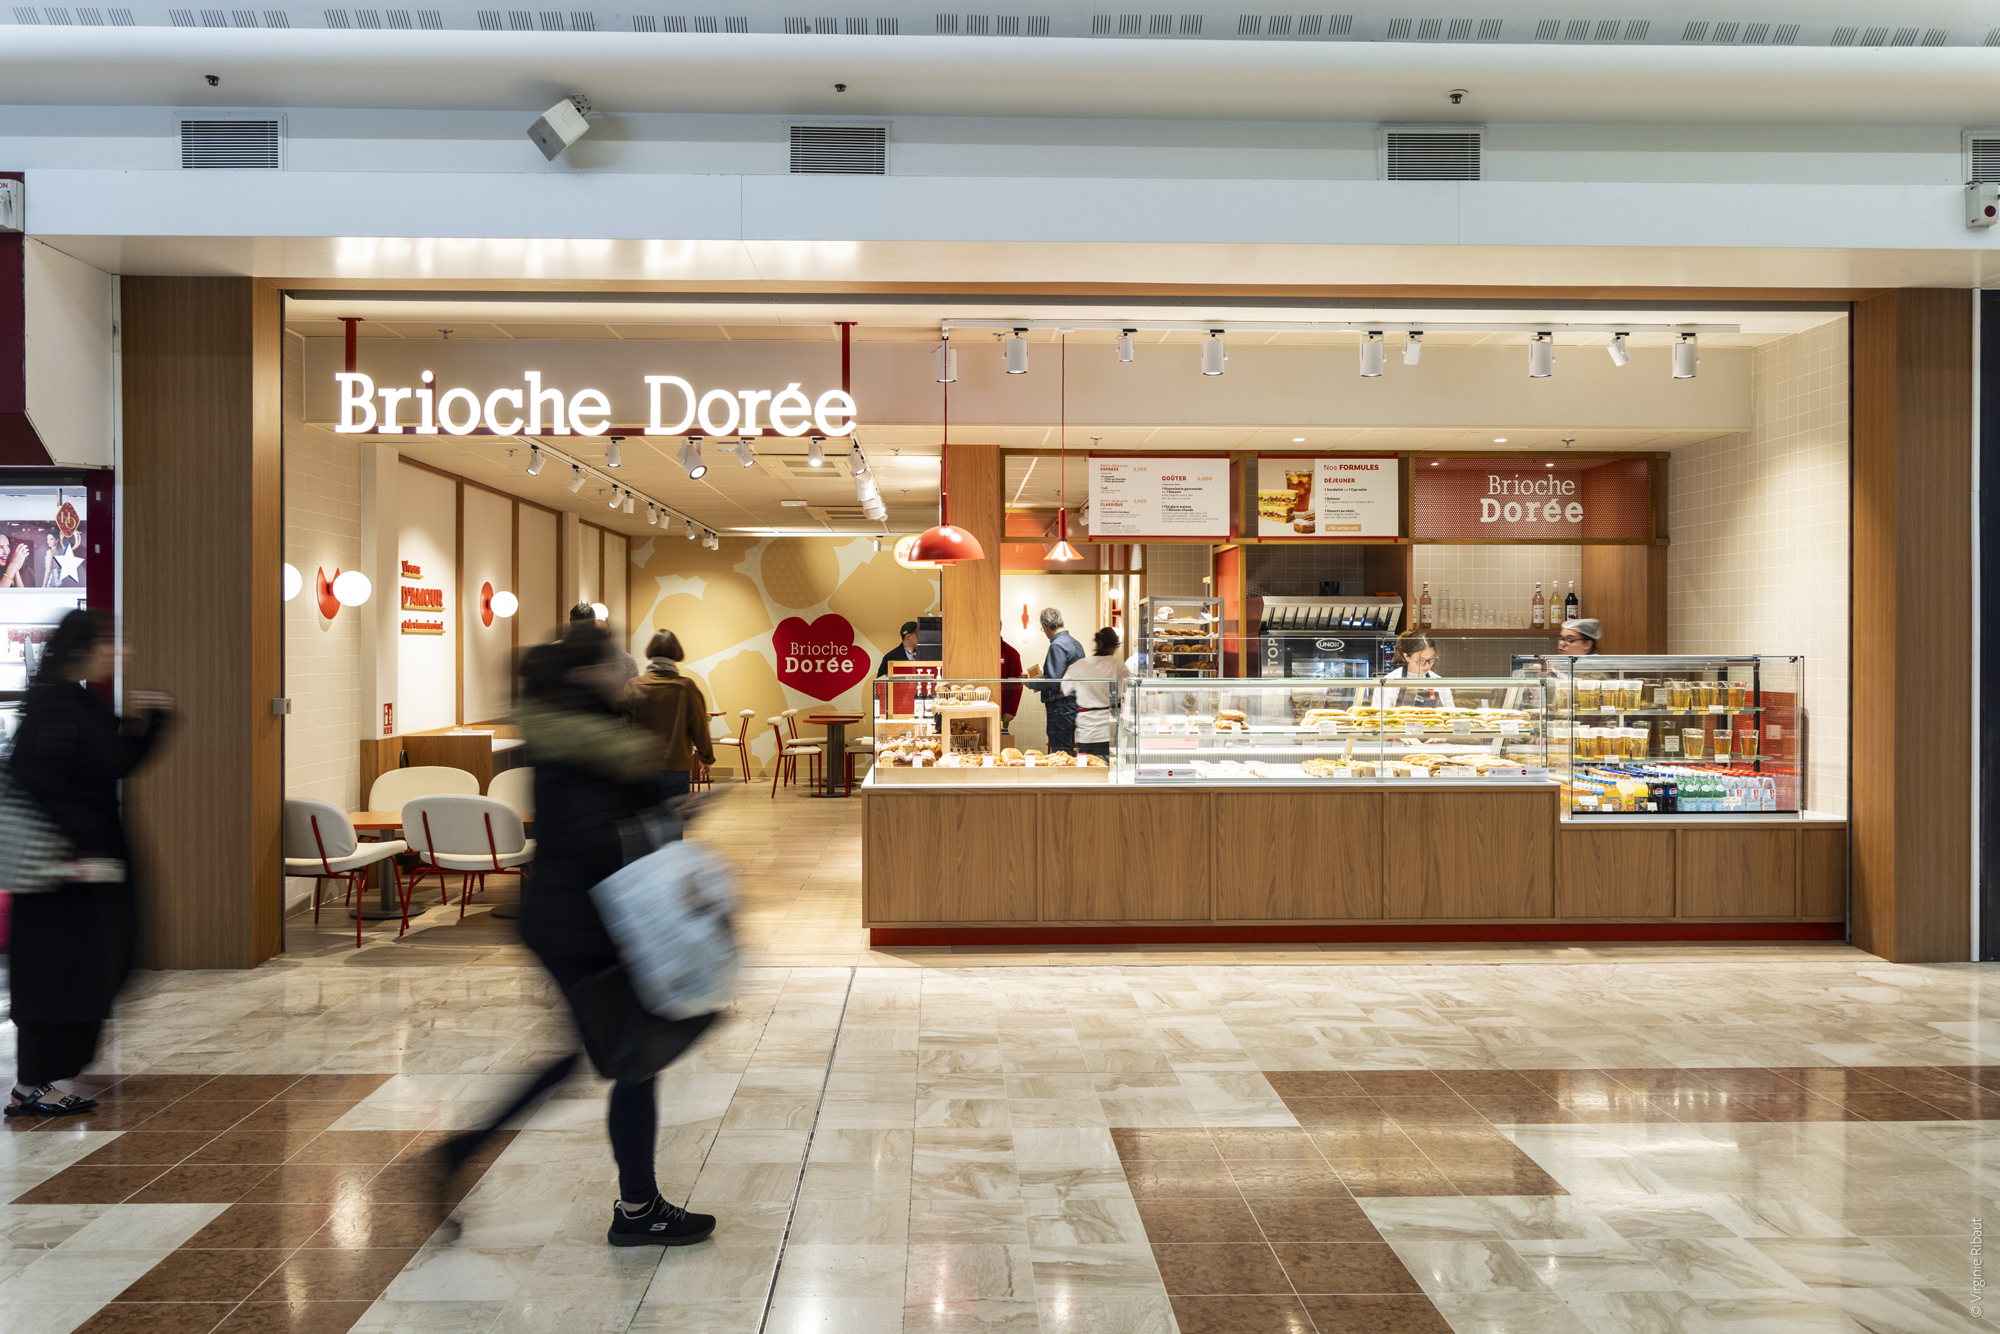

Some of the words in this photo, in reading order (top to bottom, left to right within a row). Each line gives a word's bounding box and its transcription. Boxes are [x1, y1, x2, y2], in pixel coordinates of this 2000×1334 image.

[334, 369, 612, 436] Brioche
[643, 375, 858, 436] Dorée
[1487, 474, 1576, 496] Brioche
[1480, 498, 1584, 523] Dorée
[401, 586, 443, 607] D'AMOUR
[790, 641, 848, 655] Brioche
[785, 657, 854, 673] Dorée
